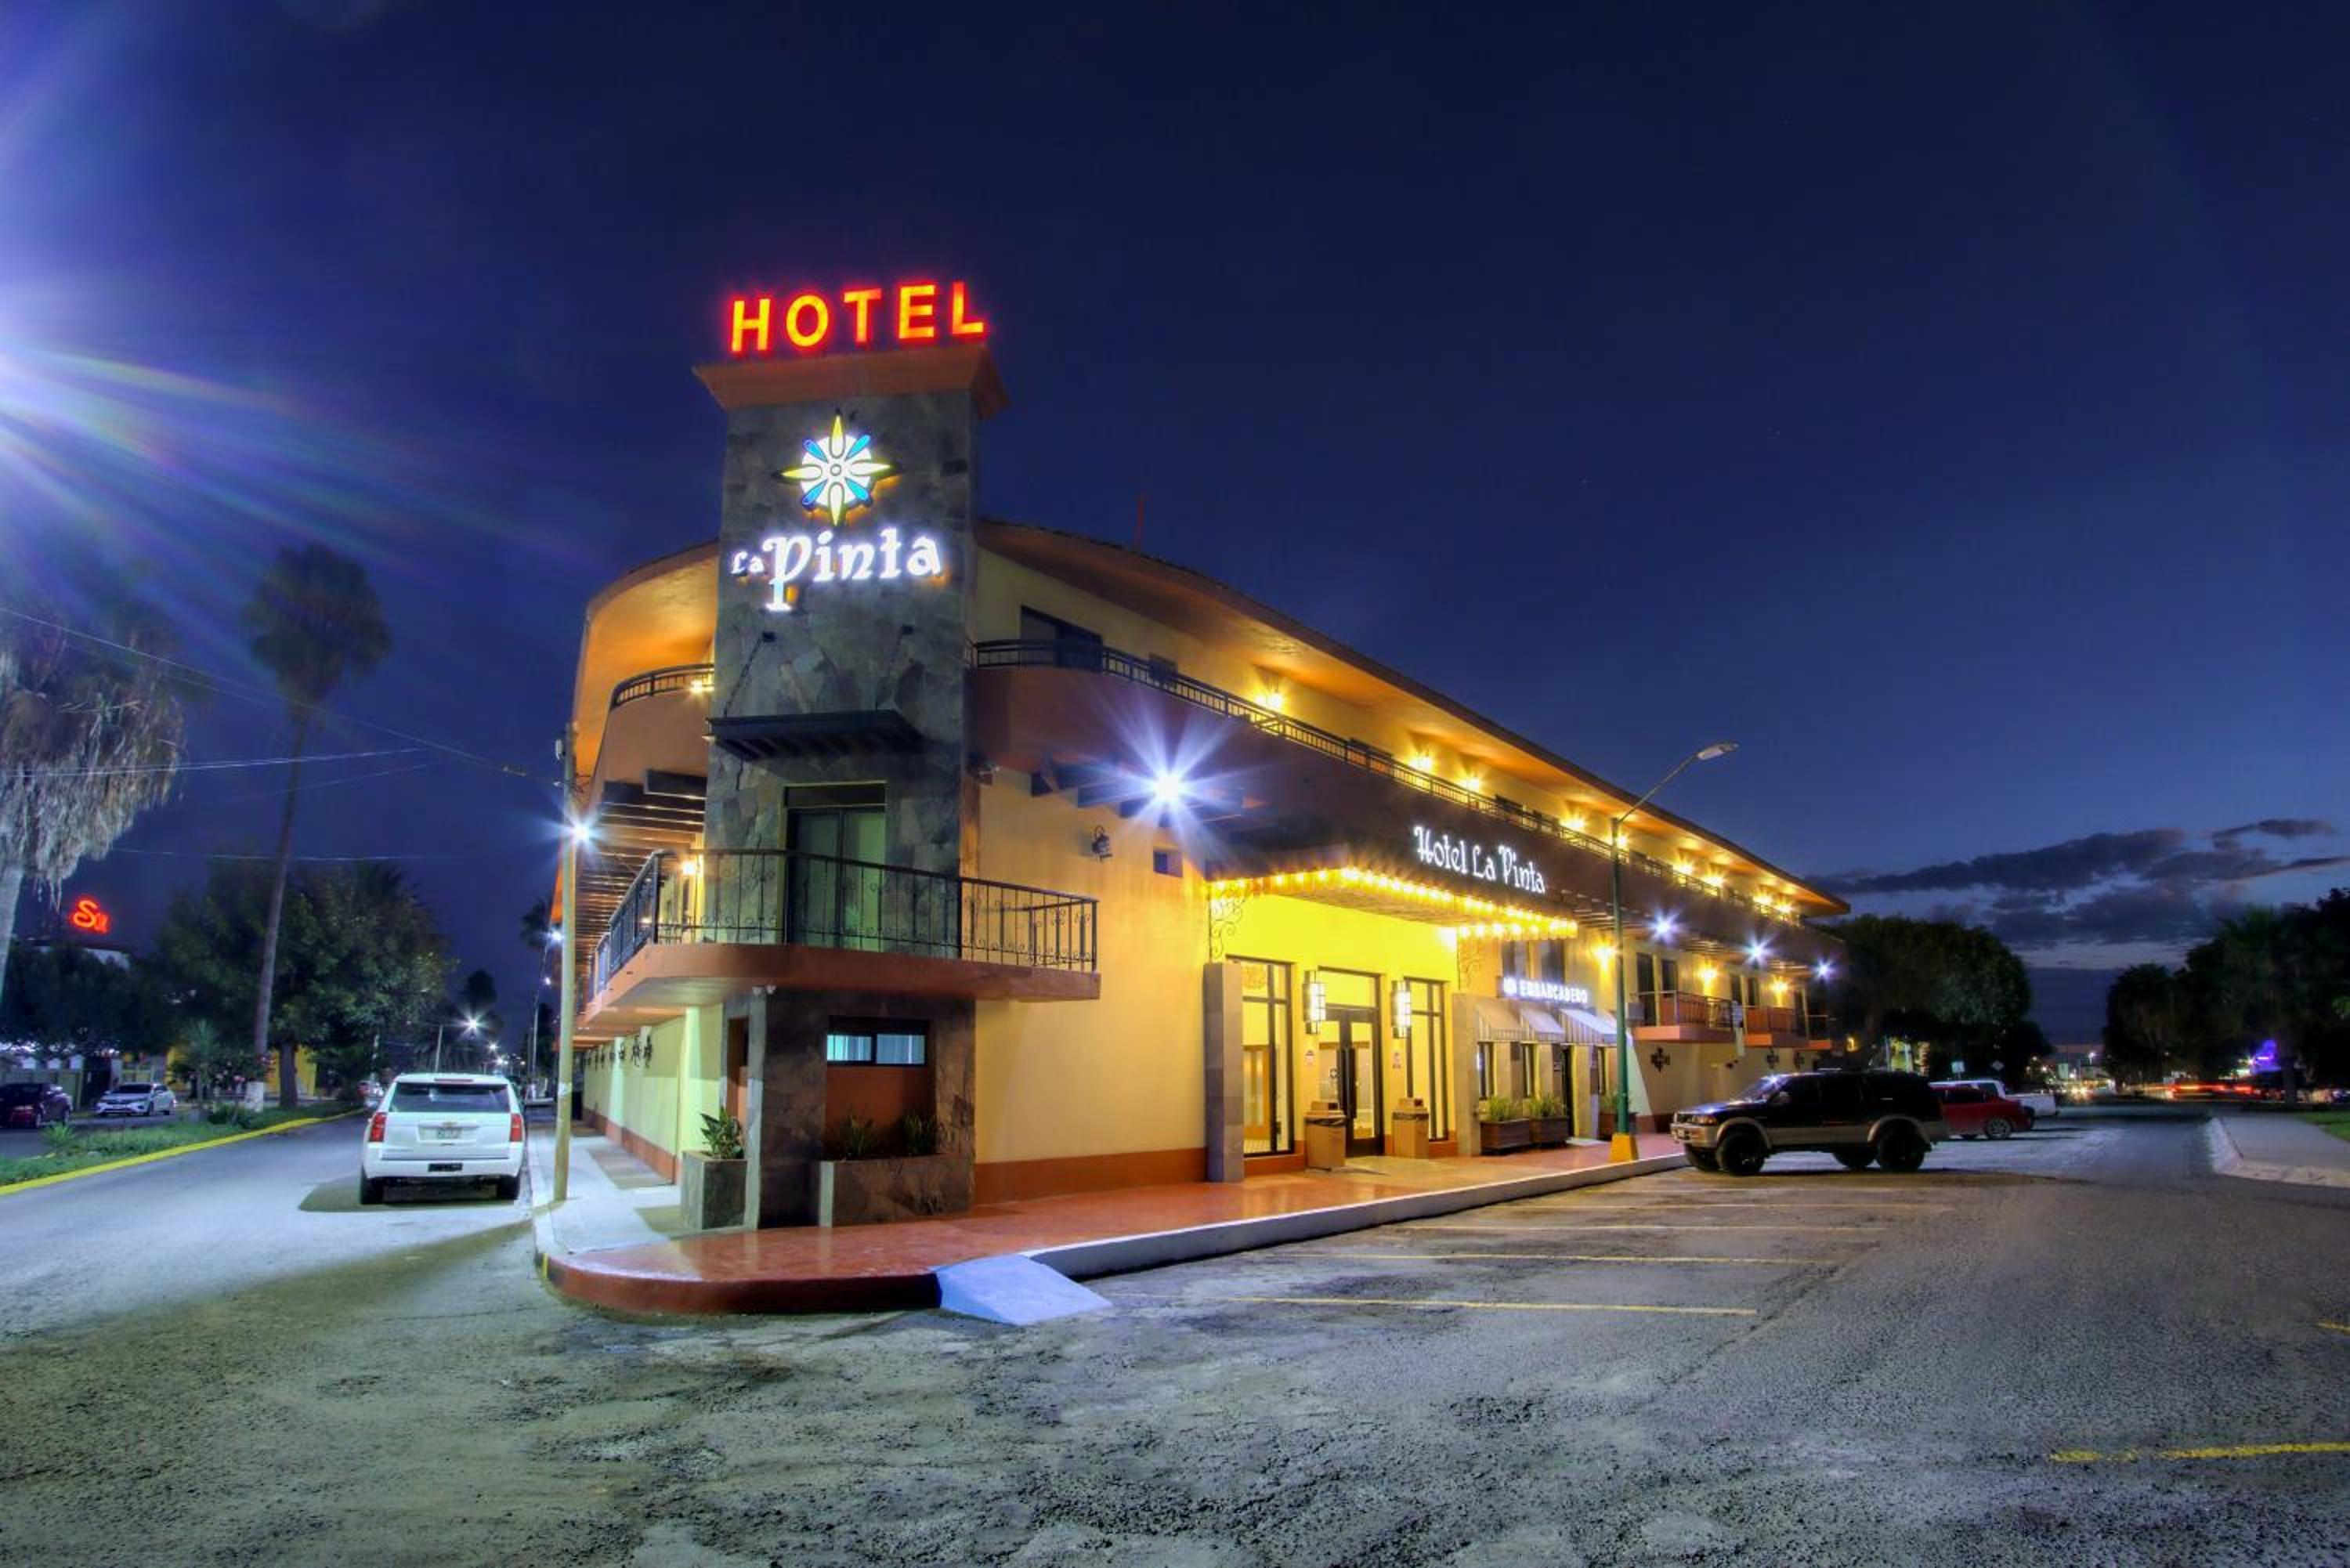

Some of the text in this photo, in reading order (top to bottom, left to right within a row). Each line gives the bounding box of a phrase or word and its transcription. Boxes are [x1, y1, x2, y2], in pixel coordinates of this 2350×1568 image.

[731, 281, 985, 352] HOTEL
[731, 527, 942, 612] La Pinta
[1413, 826, 1546, 894] Hotel La Pinta
